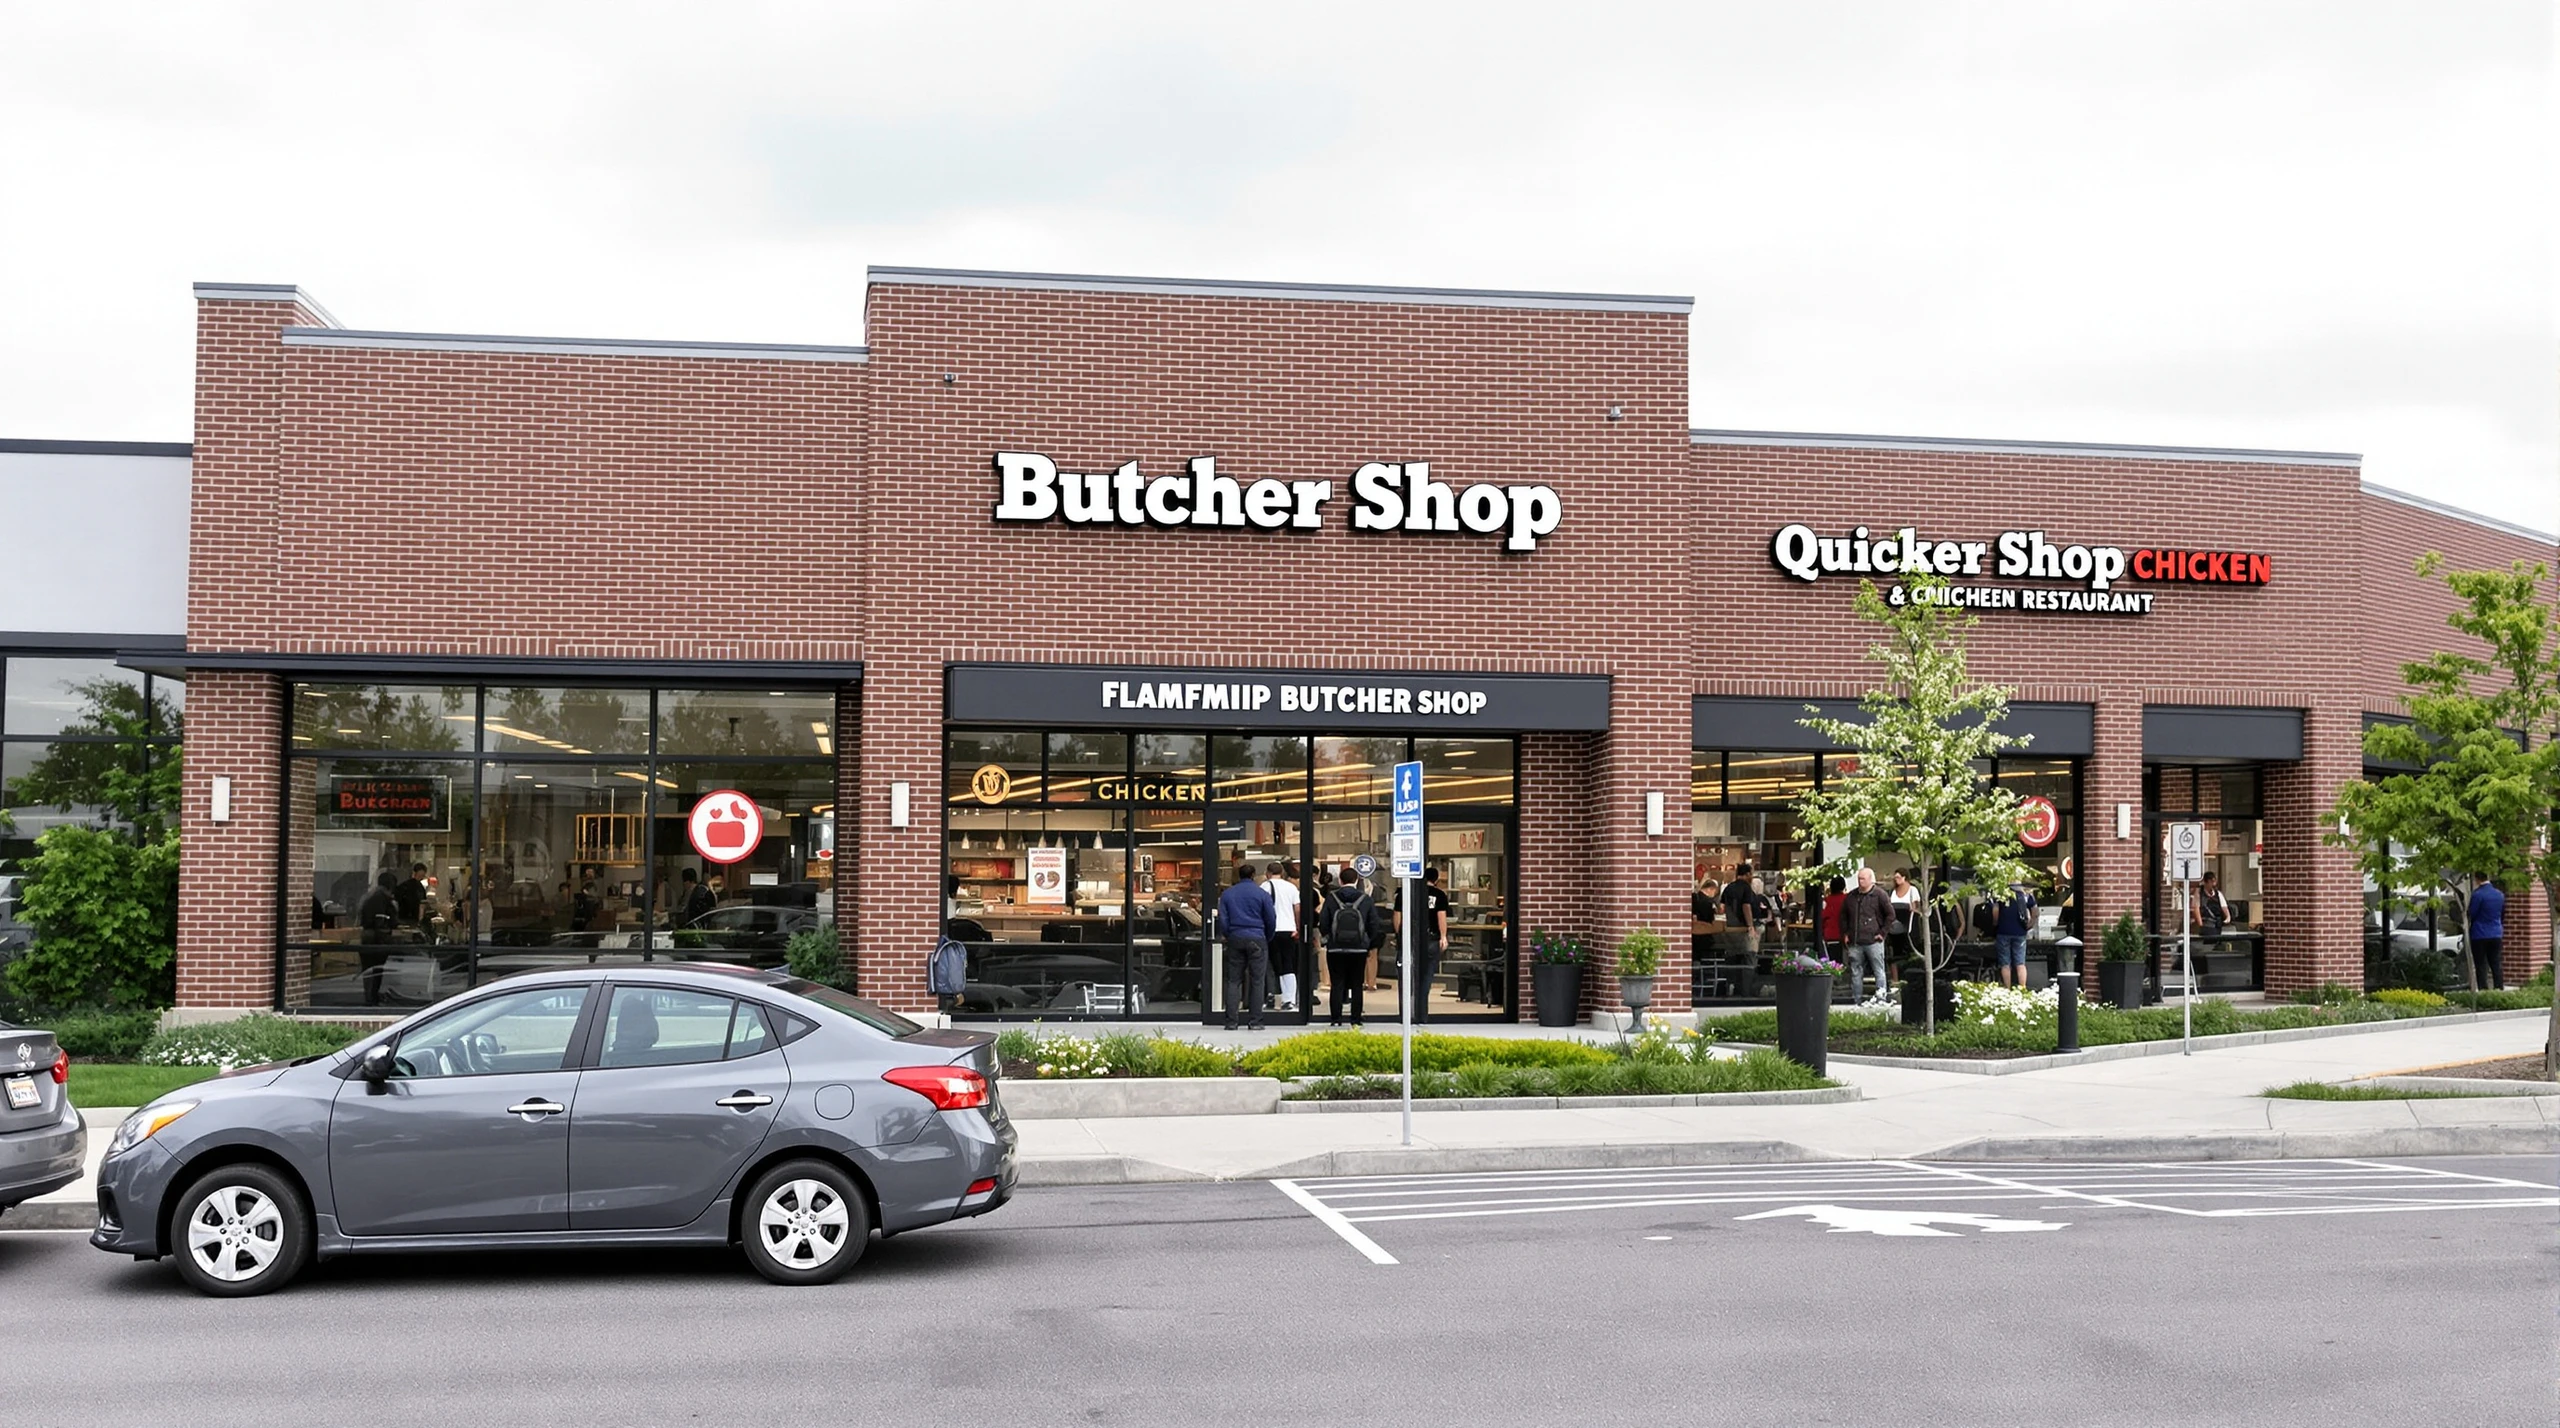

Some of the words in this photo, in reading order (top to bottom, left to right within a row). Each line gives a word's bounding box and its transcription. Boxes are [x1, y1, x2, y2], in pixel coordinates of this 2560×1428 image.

[994, 451, 1333, 530] Butcher
[1353, 460, 1564, 551] Shop
[1774, 523, 1987, 582] Quicker
[1998, 530, 2126, 590] Shop
[2132, 549, 2272, 584] CHICKEN
[1889, 584, 1906, 606] &
[2022, 588, 2155, 614] RESTAURANT
[1101, 680, 1272, 712] FLAMFMIIP
[1279, 684, 1413, 715] BUTCHER
[1415, 689, 1488, 716] SHOP
[1097, 782, 1206, 802] CHICKEN
